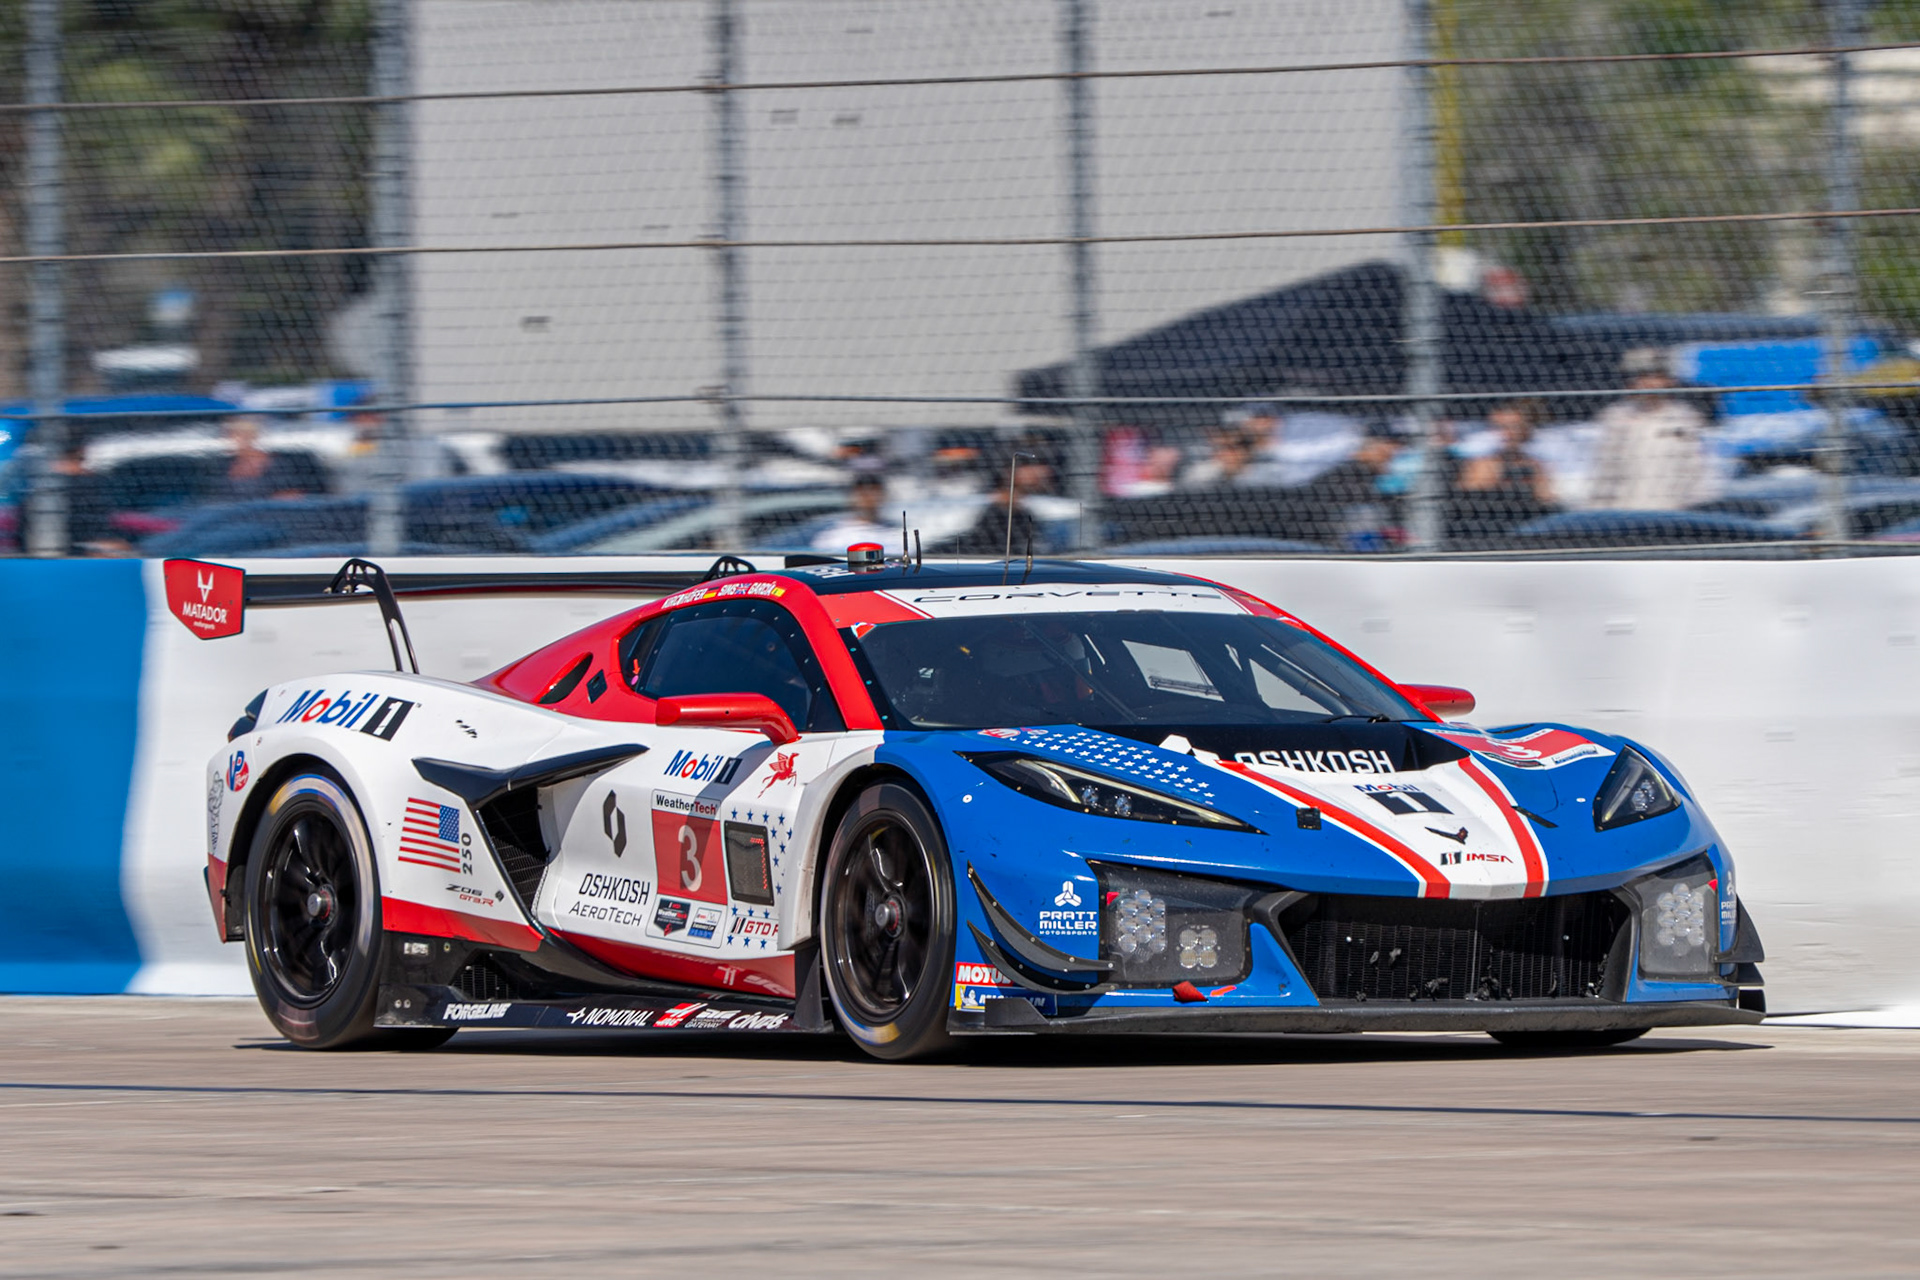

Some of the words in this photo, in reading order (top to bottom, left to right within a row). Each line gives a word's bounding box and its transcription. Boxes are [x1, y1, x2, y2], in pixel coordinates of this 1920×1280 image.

[913, 590, 1222, 603] CORVETTE
[182, 601, 227, 624] MATADOR
[276, 689, 379, 728] Mobil
[367, 698, 409, 738] 1
[229, 750, 245, 792] VP
[664, 750, 724, 782] Mobil
[717, 758, 739, 783] 1
[1234, 750, 1396, 774] OSHKOSH
[1353, 784, 1419, 793] Mobil
[656, 795, 717, 815] WeatherTech
[1376, 791, 1440, 813] 1
[461, 833, 473, 875] 250
[678, 825, 702, 892] 3
[1466, 853, 1514, 863] IMSA
[579, 873, 650, 905] OSHKOSH
[1039, 911, 1097, 920] PRATT
[1039, 920, 1097, 930] MILLER
[744, 921, 772, 936] GTD
[443, 1003, 512, 1021] FORGELINE
[582, 1008, 654, 1027] NOMINAL
